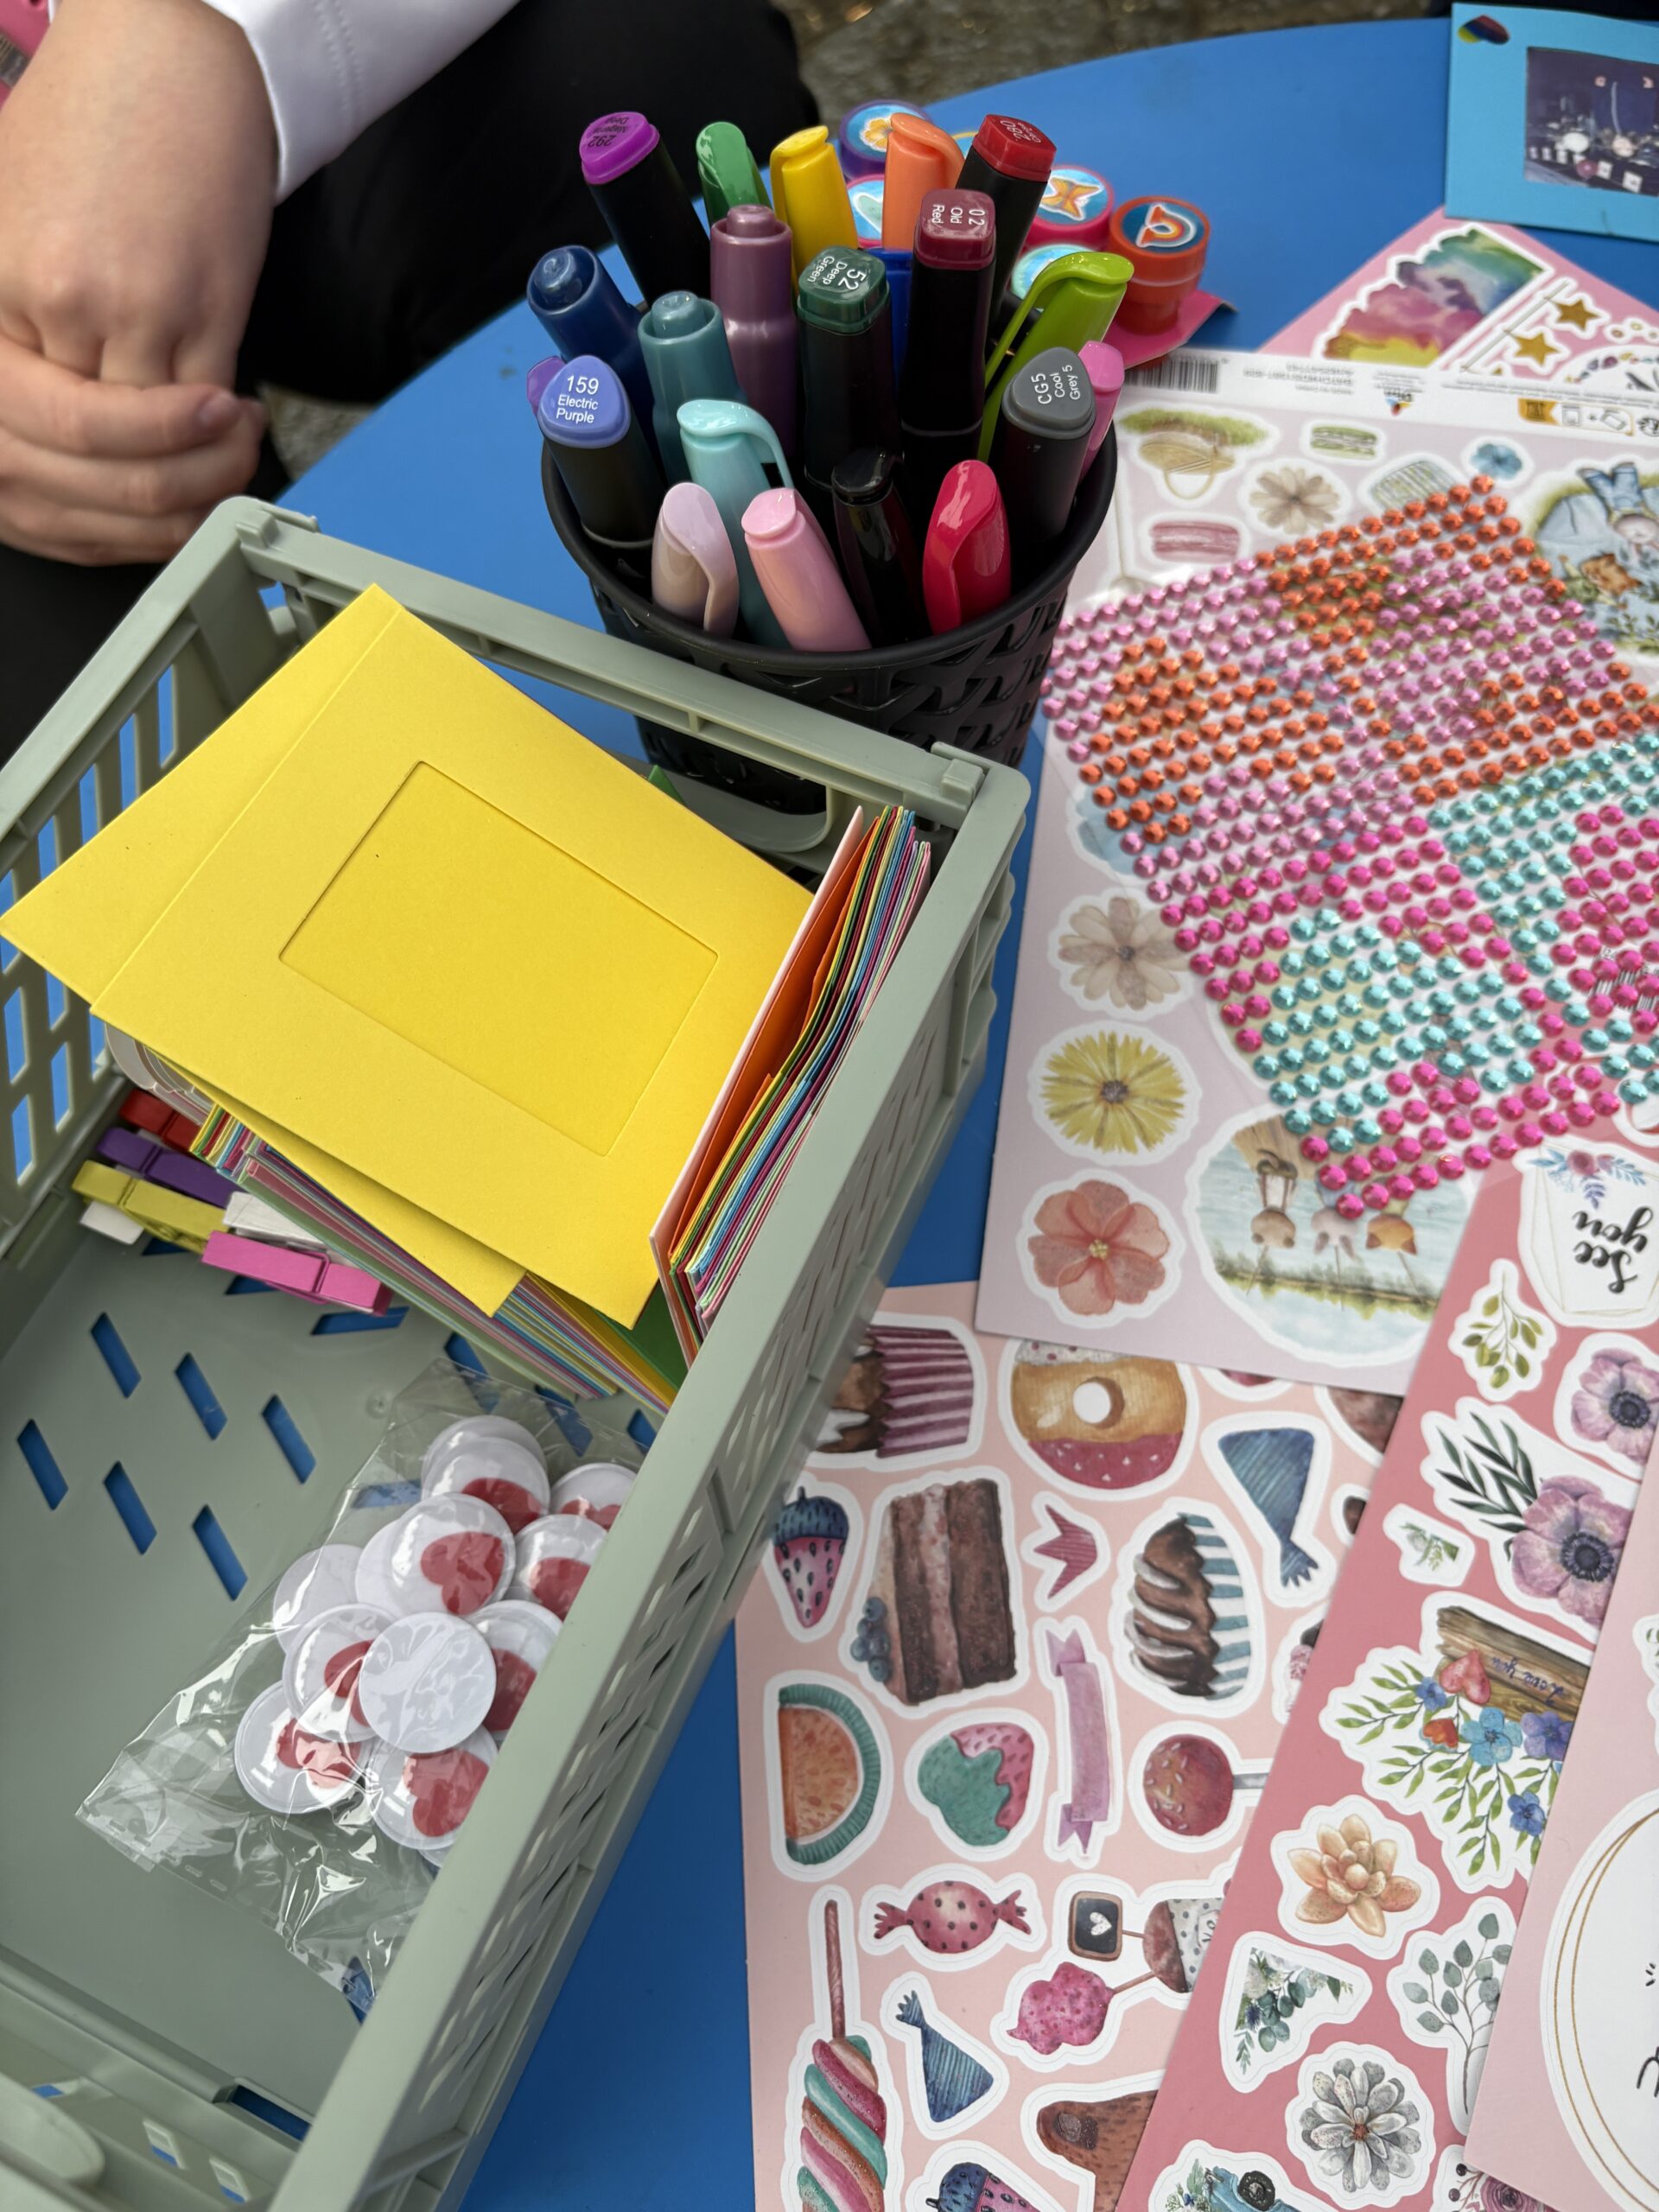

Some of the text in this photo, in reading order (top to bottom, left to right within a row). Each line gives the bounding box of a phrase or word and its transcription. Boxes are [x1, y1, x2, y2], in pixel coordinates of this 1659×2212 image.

[588, 134, 616, 147] 292
[1000, 120, 1031, 141] 280
[931, 204, 945, 224] Red
[950, 207, 963, 224] Old
[969, 209, 985, 226] 02
[806, 256, 835, 283] Green
[822, 261, 848, 285] Deep
[837, 268, 867, 290] 52
[567, 375, 599, 395] 159
[1031, 373, 1052, 404] CG5
[1049, 372, 1065, 398] Cool
[1066, 375, 1081, 400] Grey
[557, 394, 599, 410] Electric
[556, 407, 594, 424] Purple
[1572, 1205, 1654, 1254] you
[1573, 1241, 1638, 1294] See
